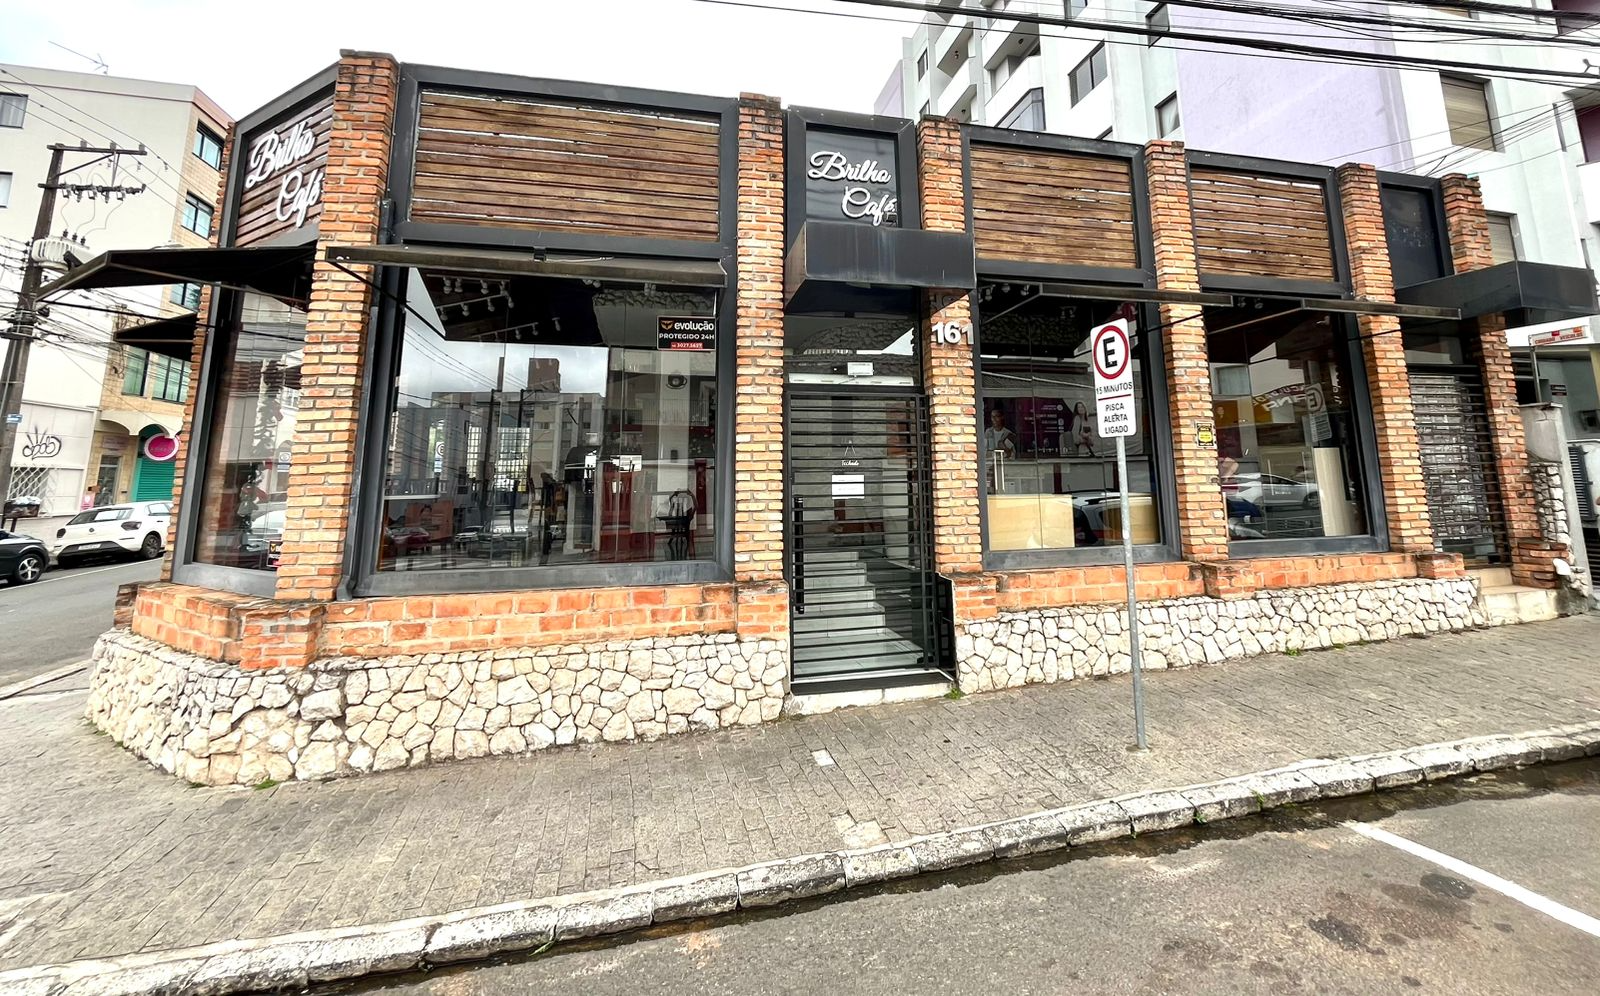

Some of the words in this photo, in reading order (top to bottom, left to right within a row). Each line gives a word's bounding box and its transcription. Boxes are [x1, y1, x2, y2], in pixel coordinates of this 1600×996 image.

[245, 121, 316, 189] Brilho
[807, 151, 892, 183] Brilho
[276, 169, 324, 228] Café
[841, 186, 898, 226] Café
[674, 321, 715, 331] evolução
[931, 321, 975, 345] 161
[1103, 336, 1118, 369] E
[1096, 386, 1102, 395] 15
[1103, 381, 1133, 394] MINUTOS
[1104, 413, 1128, 423] ALERTA
[1105, 402, 1125, 412] PISCA
[1105, 425, 1129, 435] LIGADO
